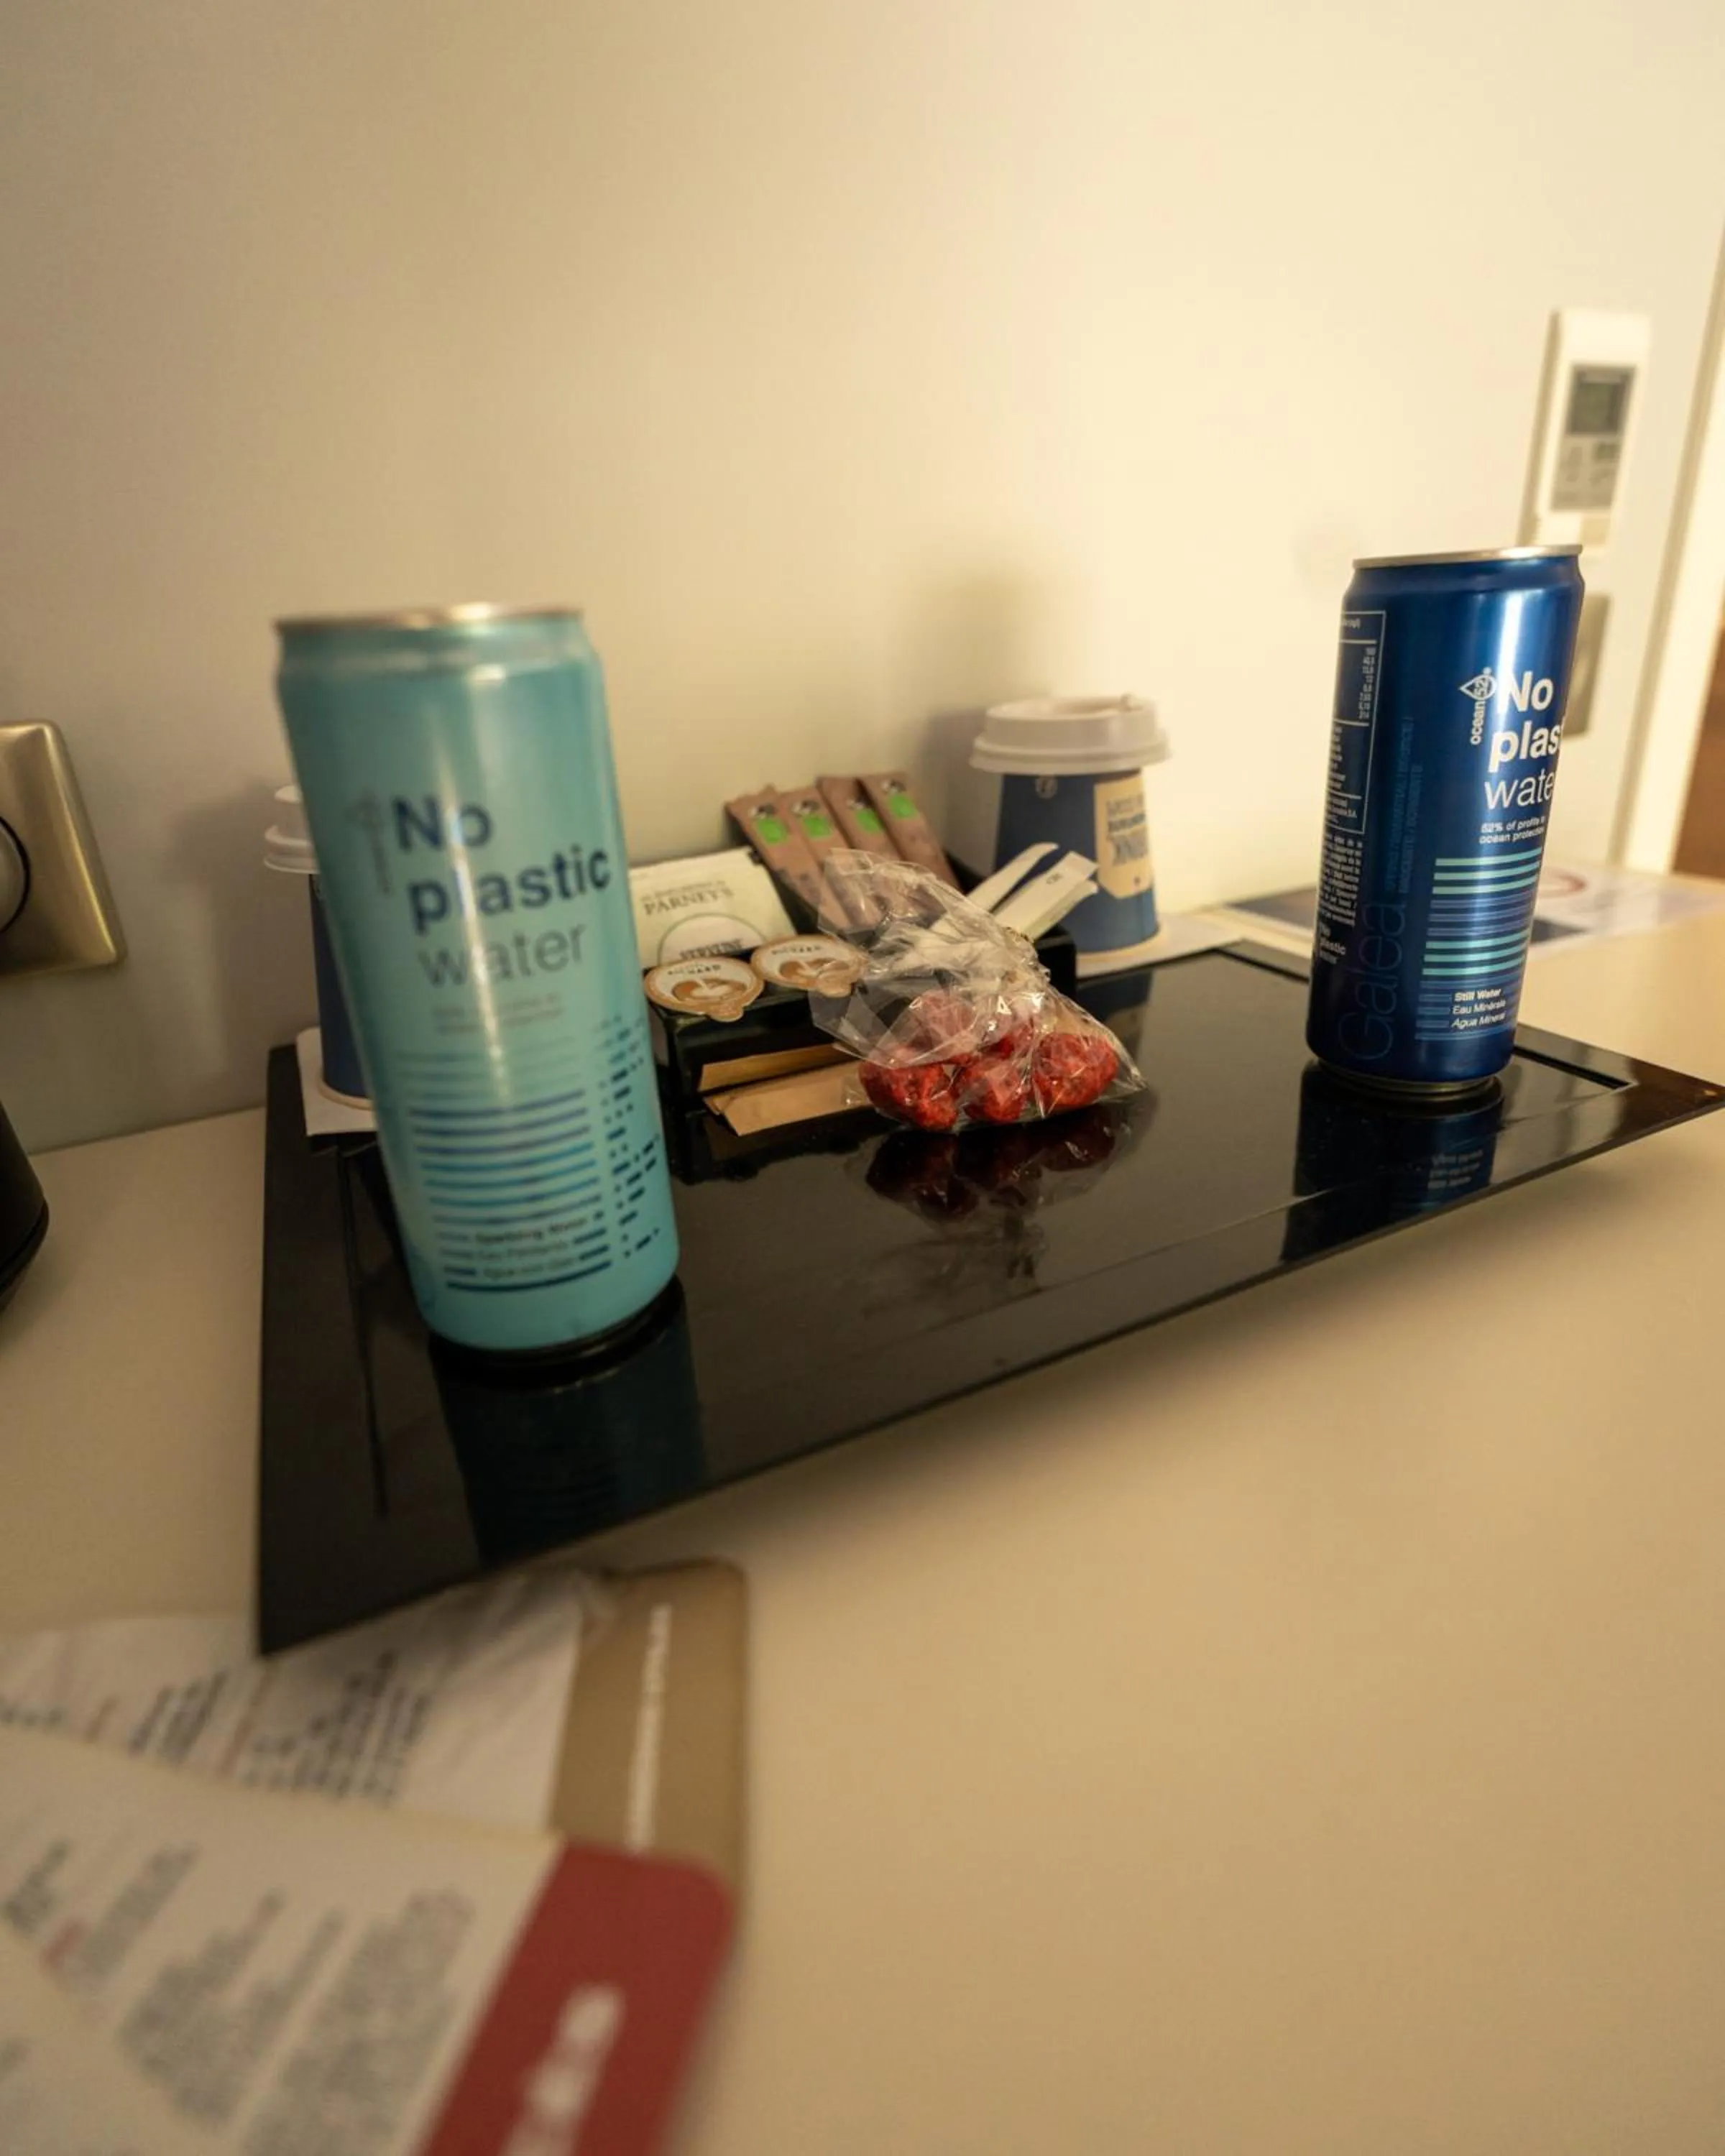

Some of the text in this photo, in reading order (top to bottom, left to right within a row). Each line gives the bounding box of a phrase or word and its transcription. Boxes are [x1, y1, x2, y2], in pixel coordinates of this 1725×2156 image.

[1497, 671, 1553, 715] No
[1488, 720, 1562, 773] plas
[392, 794, 493, 851] No
[1478, 834, 1510, 844] ocean
[417, 923, 587, 988] water
